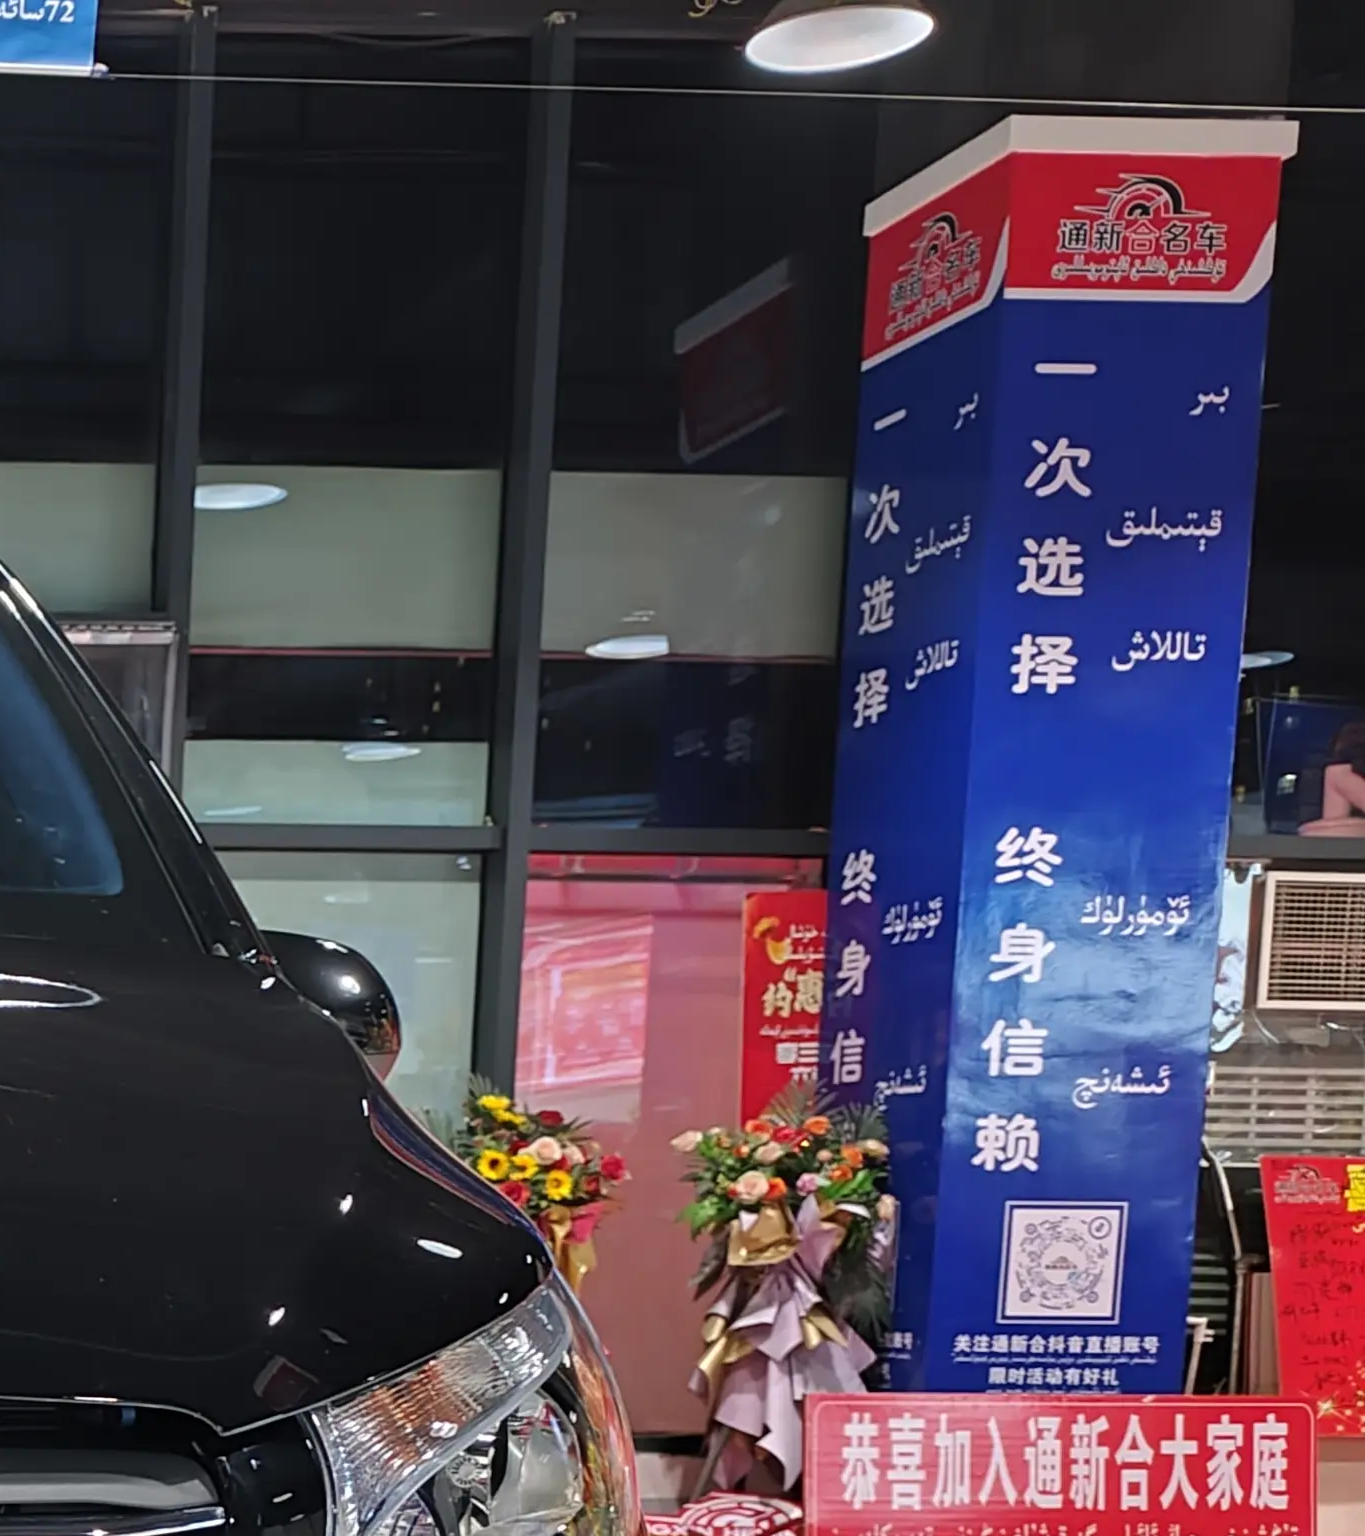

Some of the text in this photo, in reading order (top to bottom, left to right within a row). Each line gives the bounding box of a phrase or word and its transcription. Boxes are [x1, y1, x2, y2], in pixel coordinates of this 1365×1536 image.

[1057, 219, 1227, 256] 通新合名车
[953, 392, 979, 431] بىر
[1189, 386, 1230, 415] بىر
[1010, 362, 1098, 694] 一次选择
[1105, 506, 1222, 552] قېتىملىق
[853, 408, 908, 729] 一次选择
[1111, 631, 1207, 671] تاللاش
[1079, 895, 1191, 936] ئۆمۈرلۈك
[825, 849, 877, 1125] 终身信
[971, 827, 1063, 1173] 终身信赖
[1072, 1064, 1172, 1109] ئىشەنچ
[988, 1366, 1119, 1386] 限时活动有好礼
[840, 1413, 1290, 1512] 恭喜加入通新合大家庭
